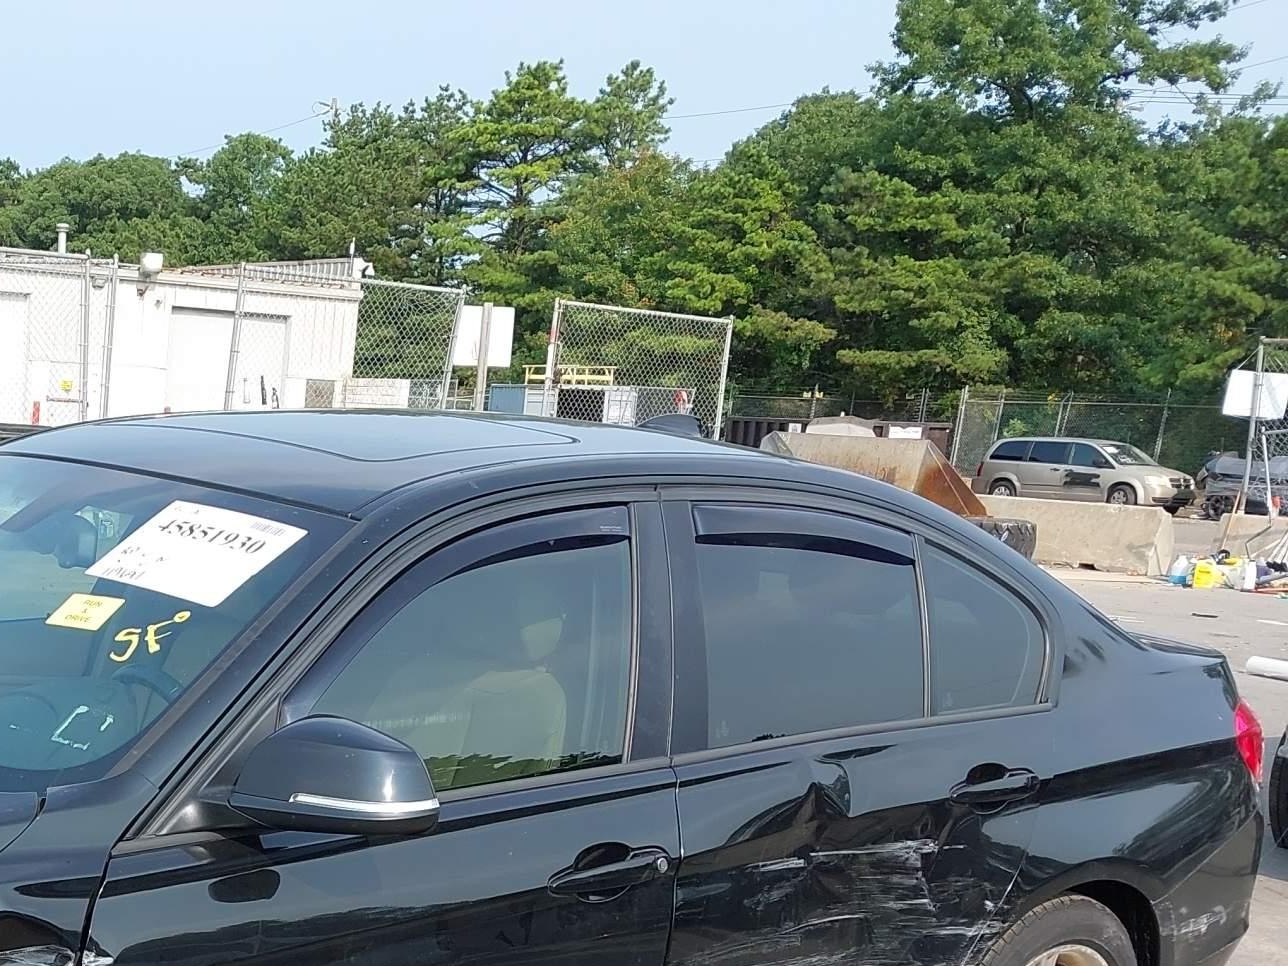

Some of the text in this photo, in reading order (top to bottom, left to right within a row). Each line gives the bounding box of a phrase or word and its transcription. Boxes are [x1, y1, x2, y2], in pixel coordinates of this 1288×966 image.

[159, 519, 266, 554] 45851930
[82, 599, 103, 607] RUN
[64, 614, 91, 623] DRIVE
